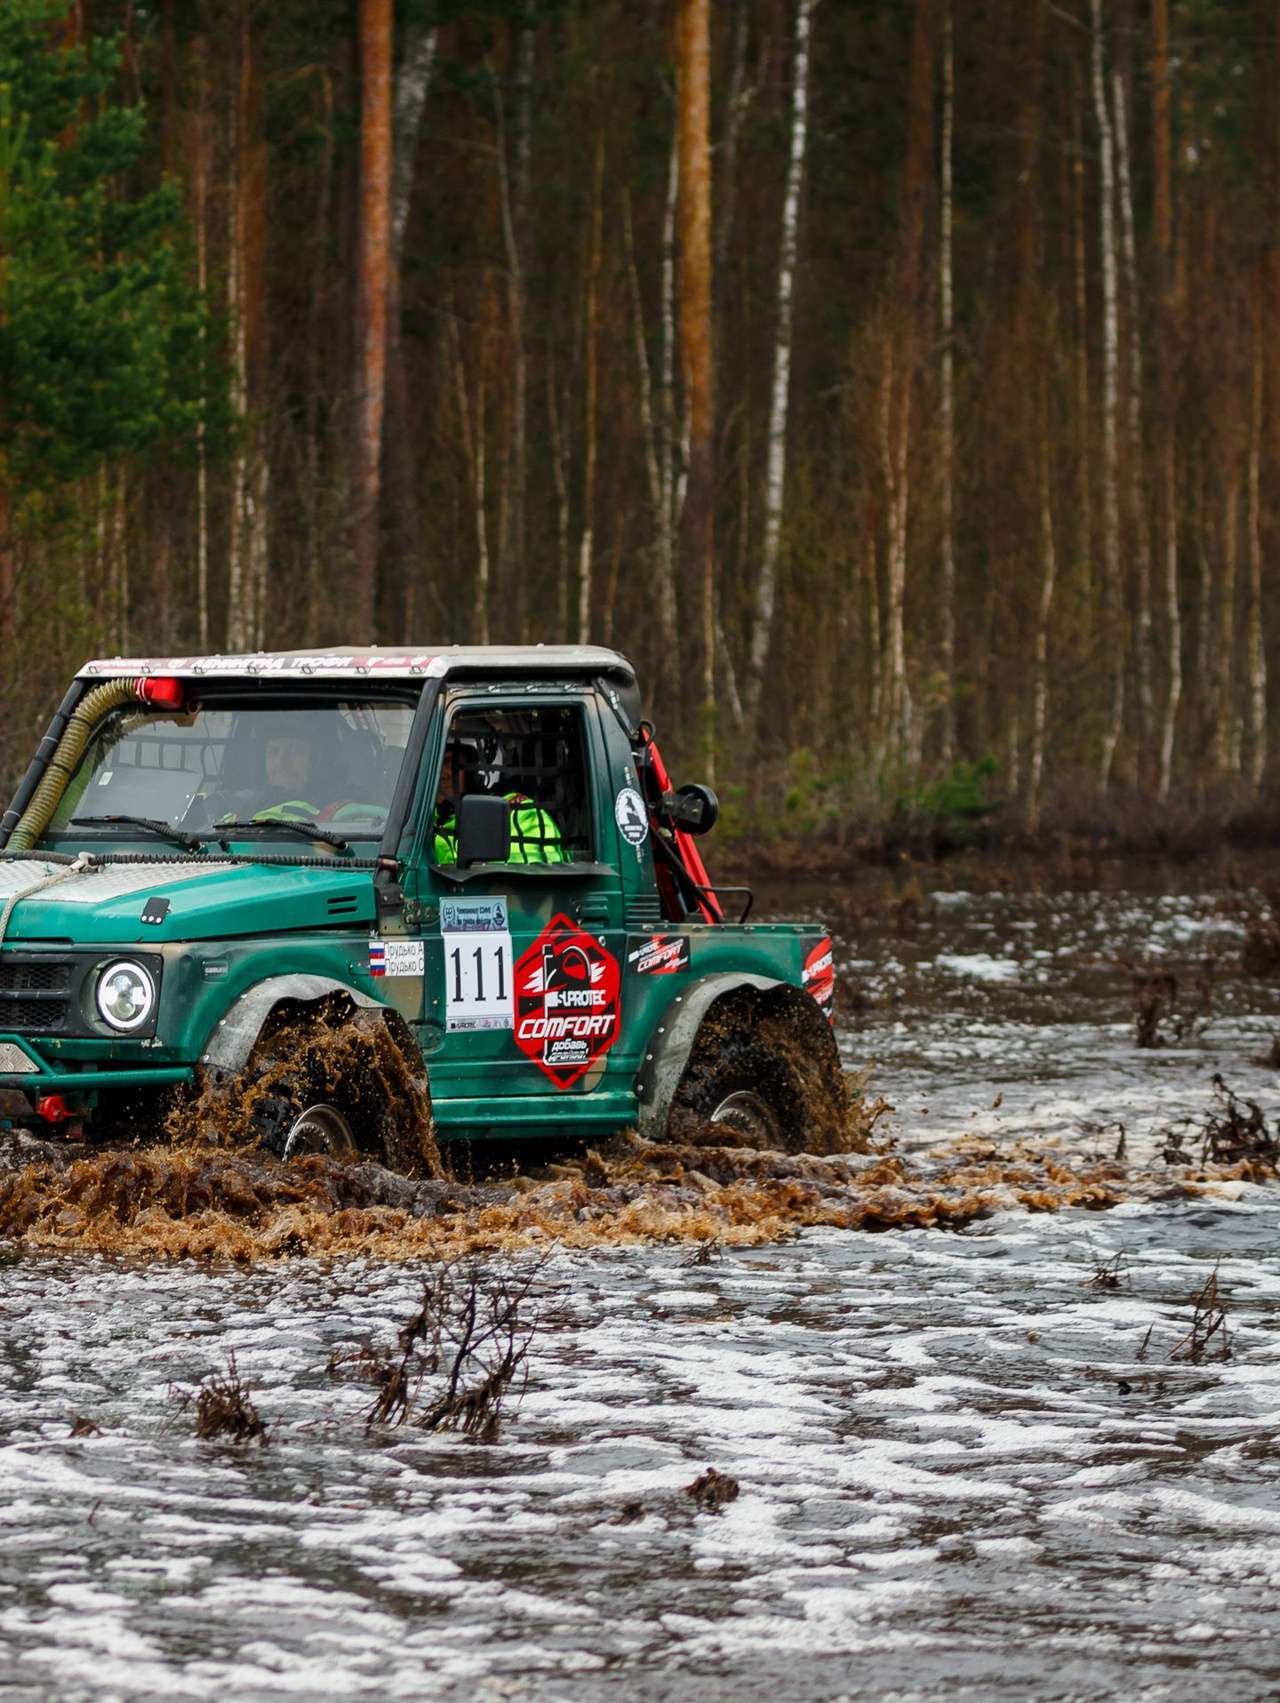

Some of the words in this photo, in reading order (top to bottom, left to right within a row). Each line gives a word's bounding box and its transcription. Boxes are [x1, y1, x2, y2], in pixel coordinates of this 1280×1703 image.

[291, 656, 354, 668] ТРОФИ
[384, 942, 417, 960] Прудько
[384, 958, 417, 976] Прудько
[450, 946, 508, 1003] 111
[556, 989, 607, 1007] SUPROTEC
[517, 1014, 616, 1039] COMFORT
